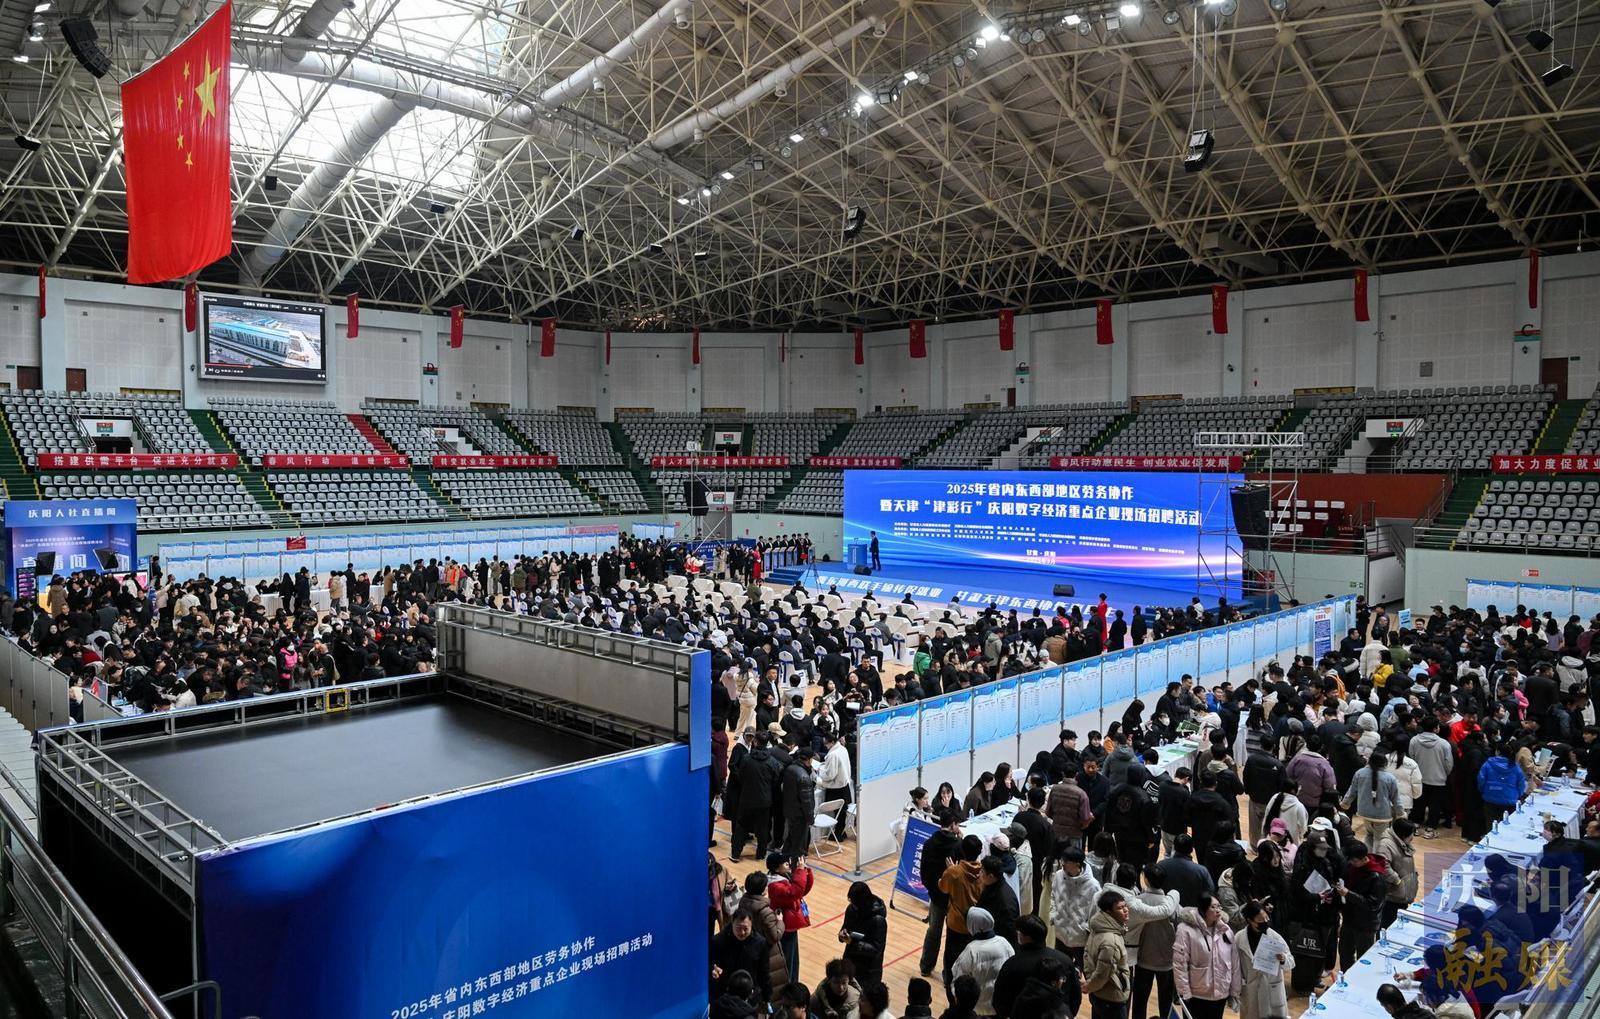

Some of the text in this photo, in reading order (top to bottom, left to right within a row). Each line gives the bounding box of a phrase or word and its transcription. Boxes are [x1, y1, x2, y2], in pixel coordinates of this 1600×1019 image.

[54, 456, 230, 467] 搭建供需平台 促进充分就业
[268, 456, 331, 466] 春风行动
[1059, 457, 1231, 468] 春风行动惠民生 创业就业促发展
[946, 482, 1135, 501] 2025年省内东西部地区劳务协作
[391, 935, 597, 1019] 2025年省内东西部地区劳务协作
